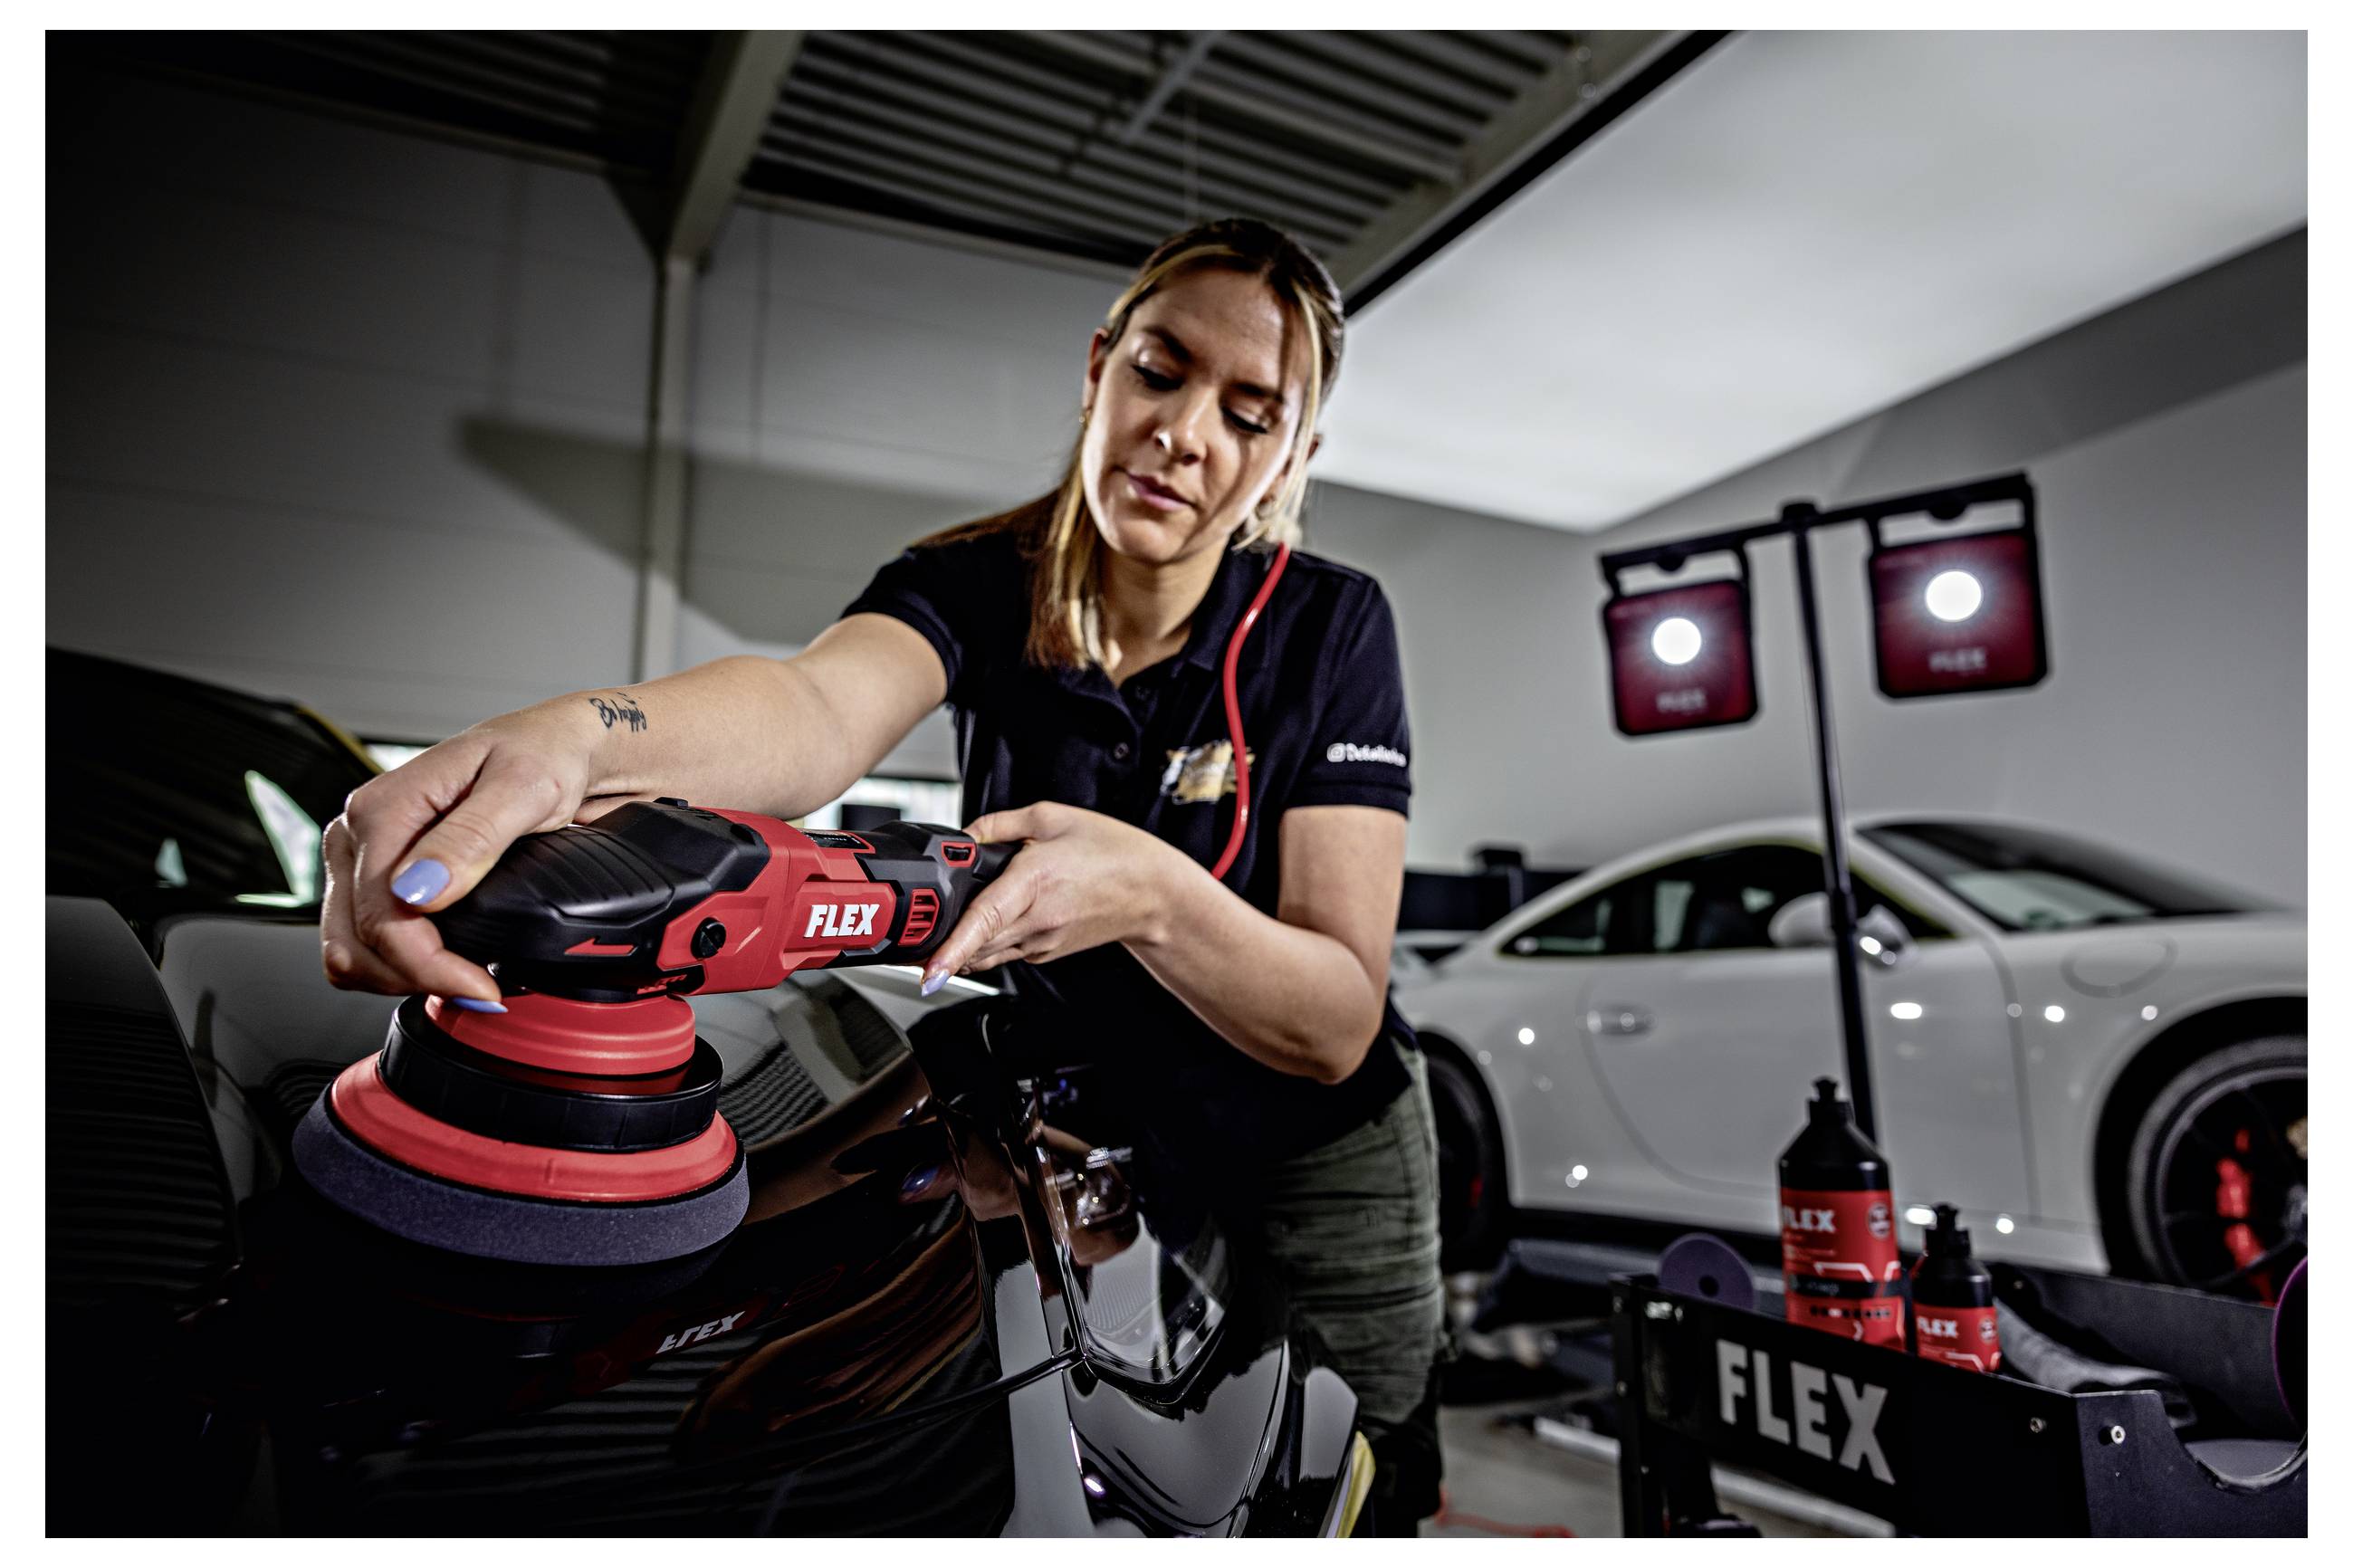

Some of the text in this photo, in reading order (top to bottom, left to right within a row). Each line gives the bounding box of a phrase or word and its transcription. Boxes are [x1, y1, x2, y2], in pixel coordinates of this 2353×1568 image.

[804, 904, 880, 938] FLEX
[1916, 1315, 1959, 1340] FLEX
[1715, 1337, 1898, 1487] FLEX
